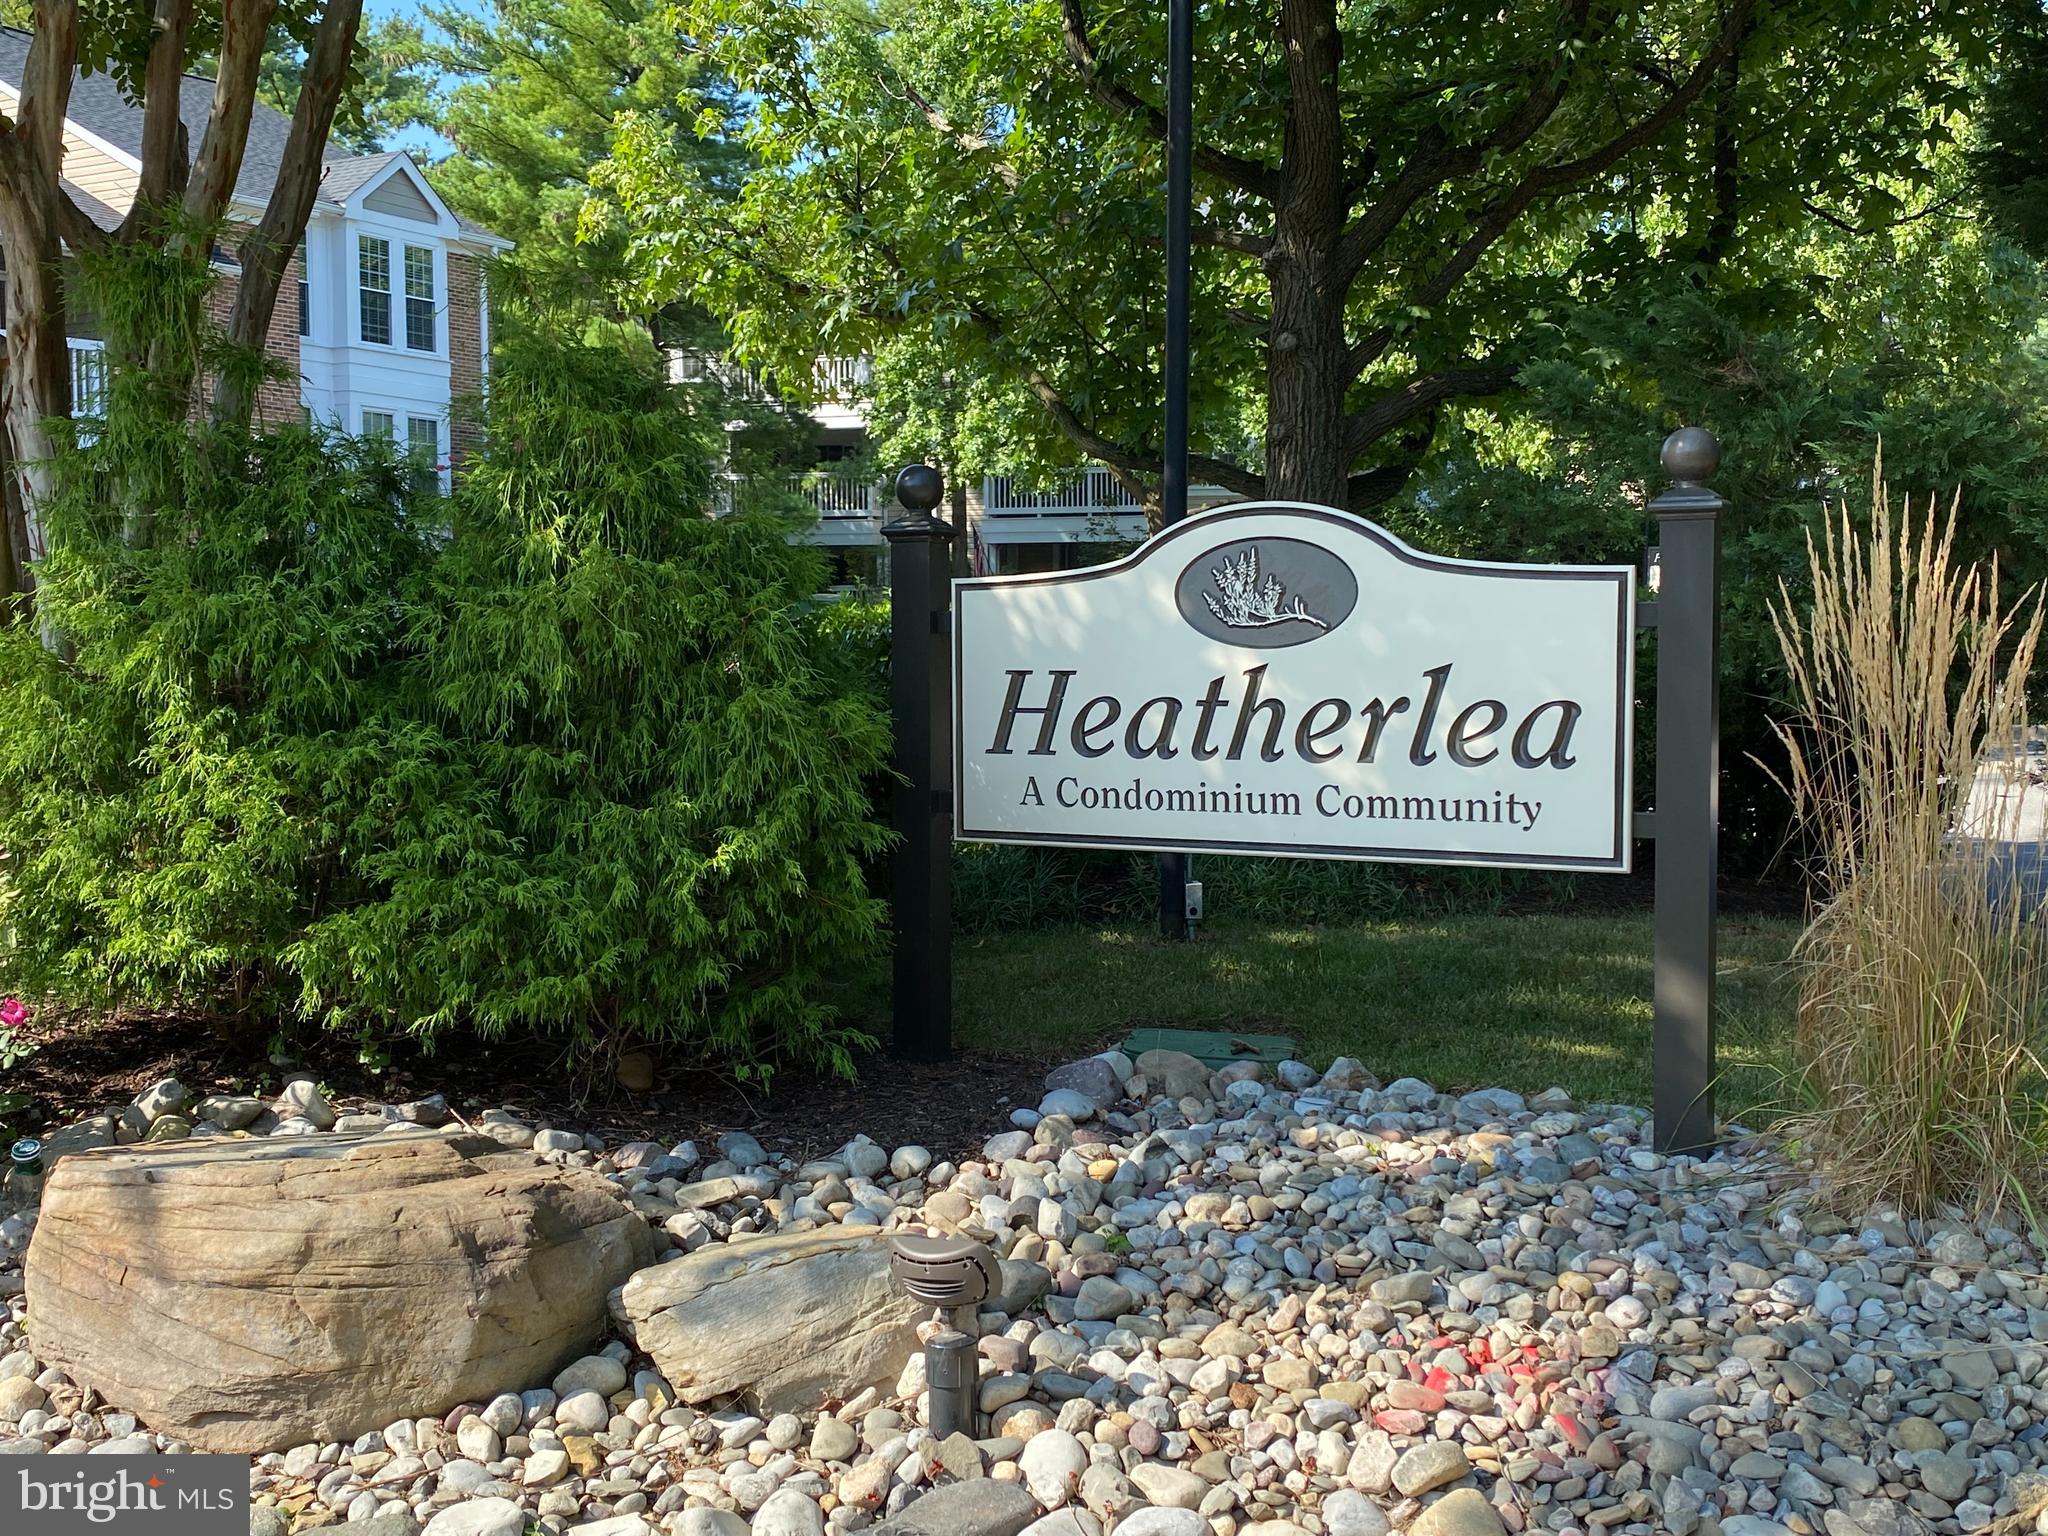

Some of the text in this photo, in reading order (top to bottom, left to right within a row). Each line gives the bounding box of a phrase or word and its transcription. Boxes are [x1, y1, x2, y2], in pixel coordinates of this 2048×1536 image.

[984, 662, 1582, 769] Heatherlea
[1019, 776, 1543, 832] A Condominium Community
